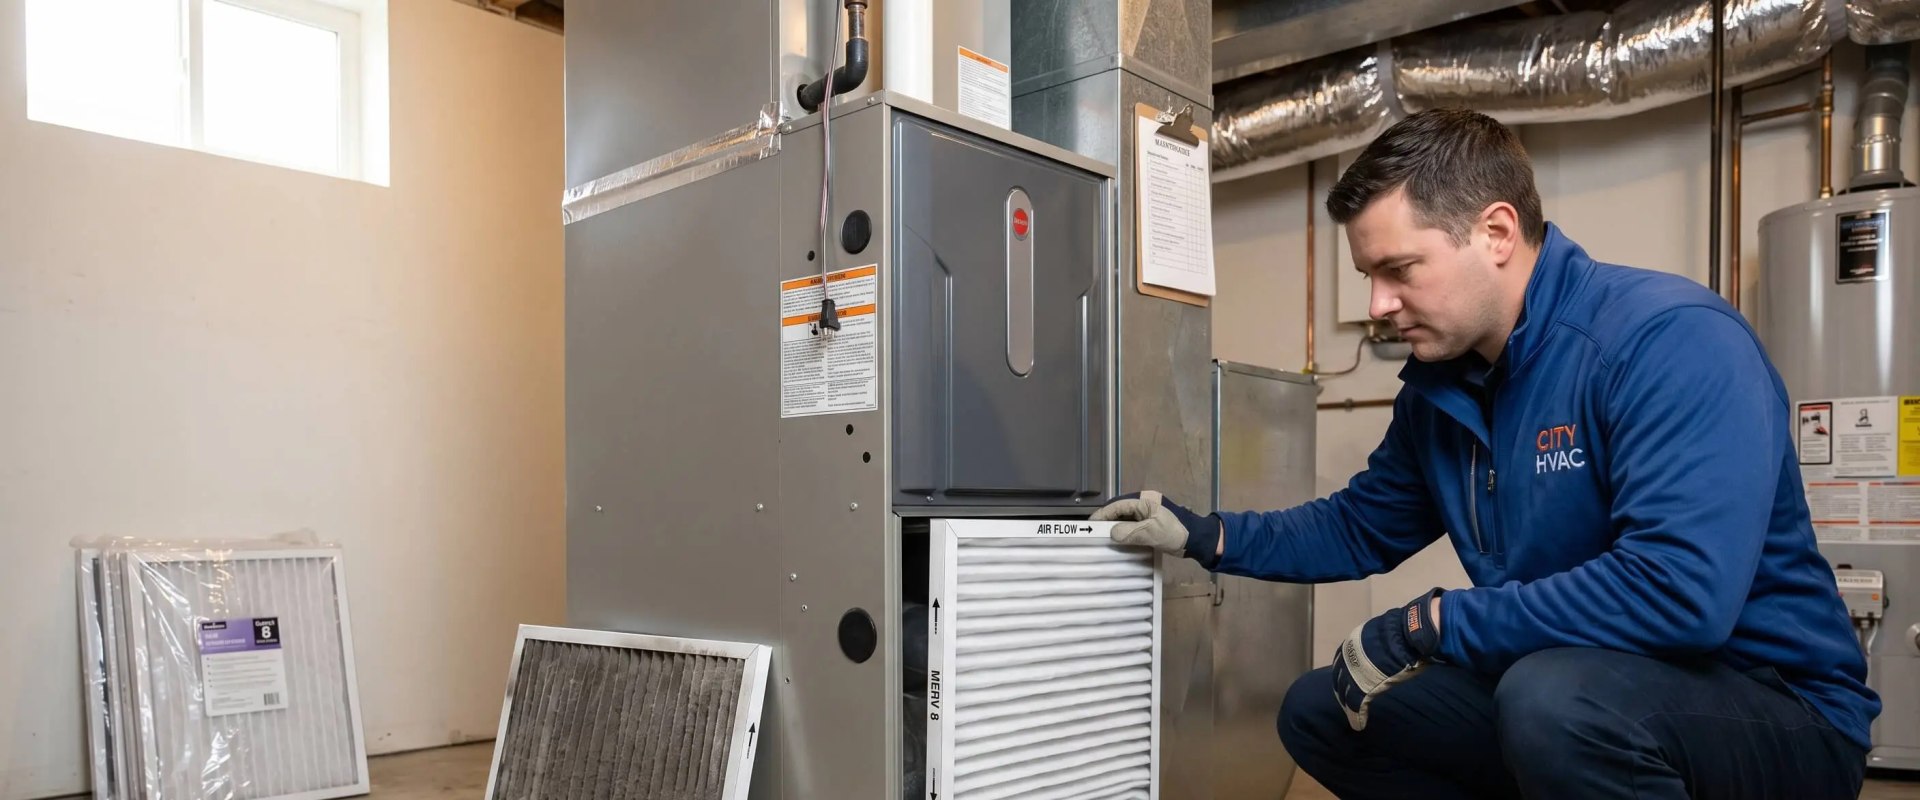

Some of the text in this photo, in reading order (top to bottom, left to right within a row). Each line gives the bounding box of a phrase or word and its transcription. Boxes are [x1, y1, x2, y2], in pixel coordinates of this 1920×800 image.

[1536, 424, 1576, 451] CITY
[1536, 448, 1585, 474] HVAC
[1037, 524, 1077, 534] AIR FLOW
[261, 626, 271, 638] 8
[930, 670, 940, 720] MERV 8
